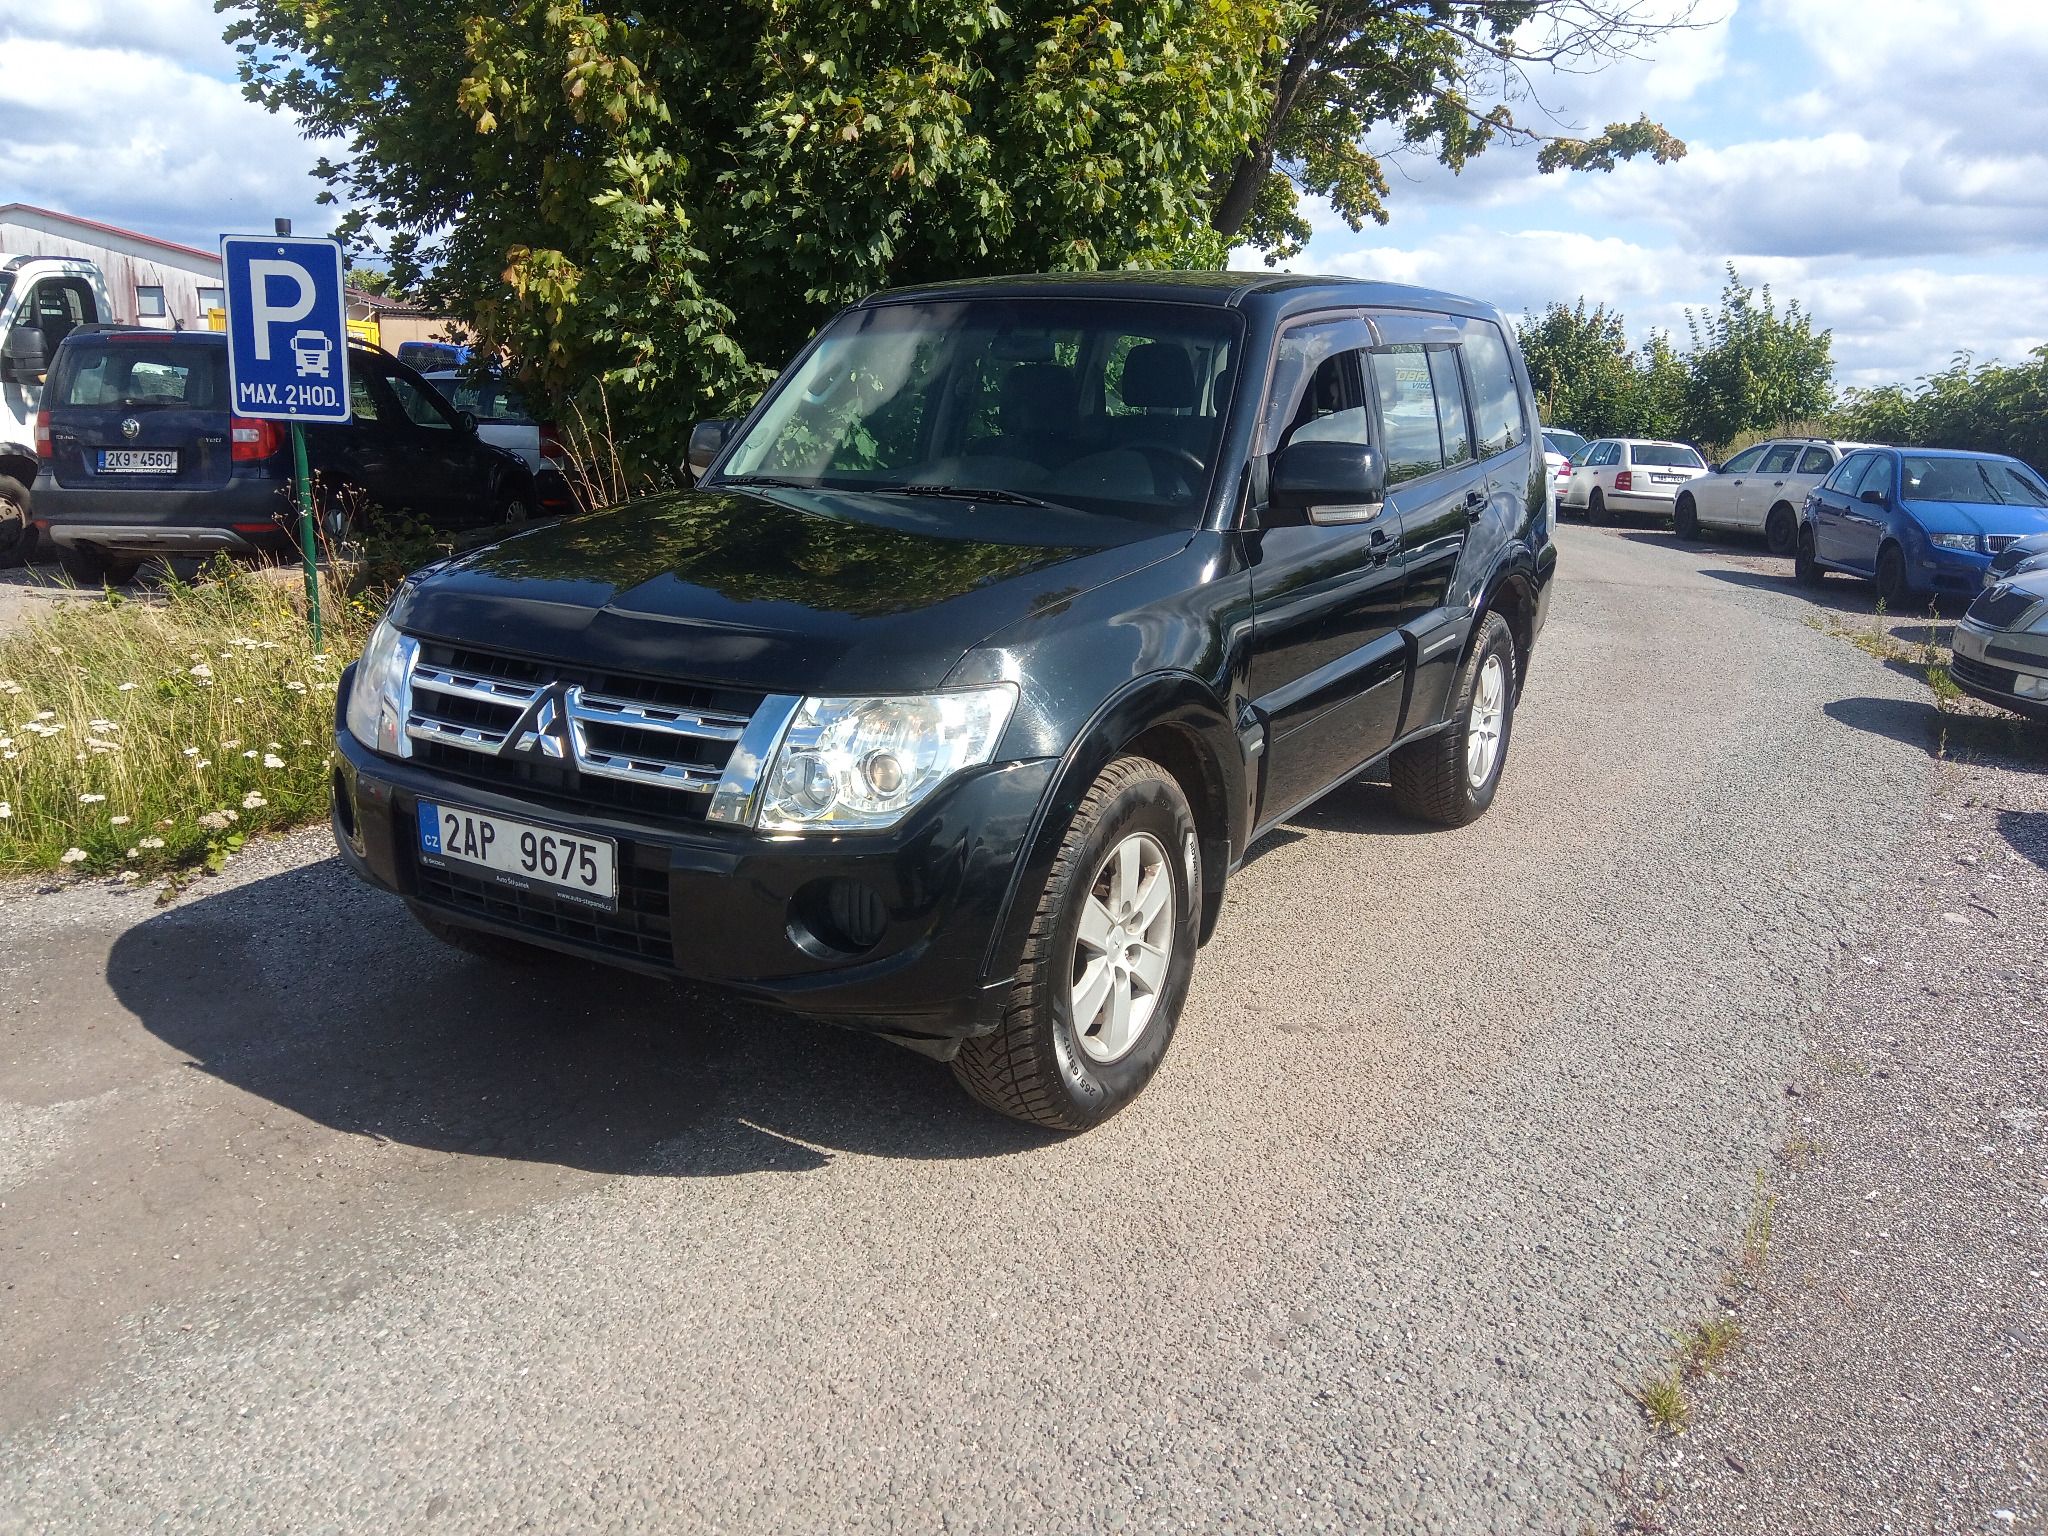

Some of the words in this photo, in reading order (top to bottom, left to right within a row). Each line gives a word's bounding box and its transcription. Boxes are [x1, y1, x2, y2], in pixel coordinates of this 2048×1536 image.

[249, 258, 317, 360] P
[240, 382, 283, 405] MAX.
[108, 453, 131, 467] 2K9
[140, 453, 171, 467] 4560
[424, 834, 439, 848] CZ
[444, 813, 496, 861] 2AP
[520, 832, 597, 886] 9675
